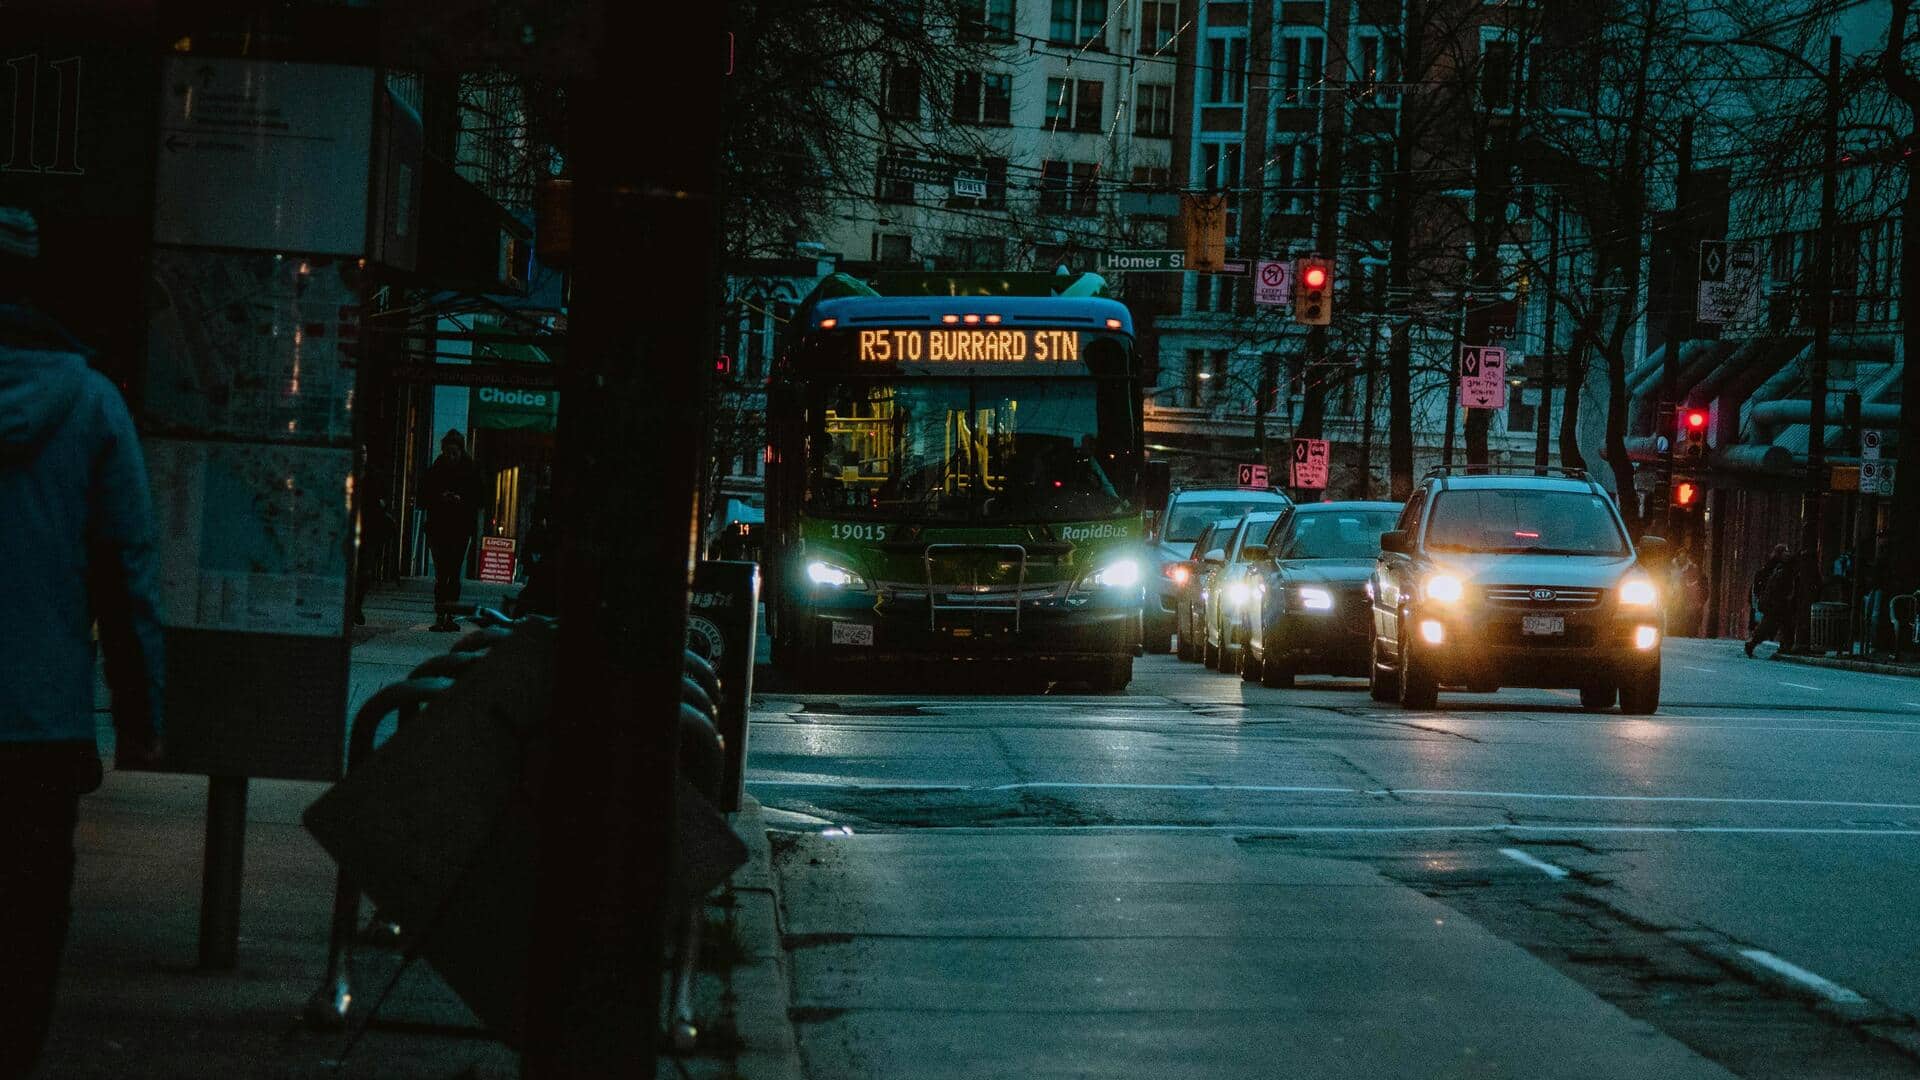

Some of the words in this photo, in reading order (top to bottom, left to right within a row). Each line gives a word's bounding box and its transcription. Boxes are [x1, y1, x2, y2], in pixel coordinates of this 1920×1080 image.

[1107, 254, 1162, 268] Homer
[859, 329, 891, 361] R5
[893, 330, 923, 361] TO
[929, 330, 1027, 361] BURRARD
[1034, 330, 1079, 361] STN
[479, 387, 547, 407] Choice
[739, 523, 750, 536] 14
[832, 524, 886, 541] 19015
[1062, 524, 1128, 541] RapidBus
[1534, 591, 1552, 599] KIA
